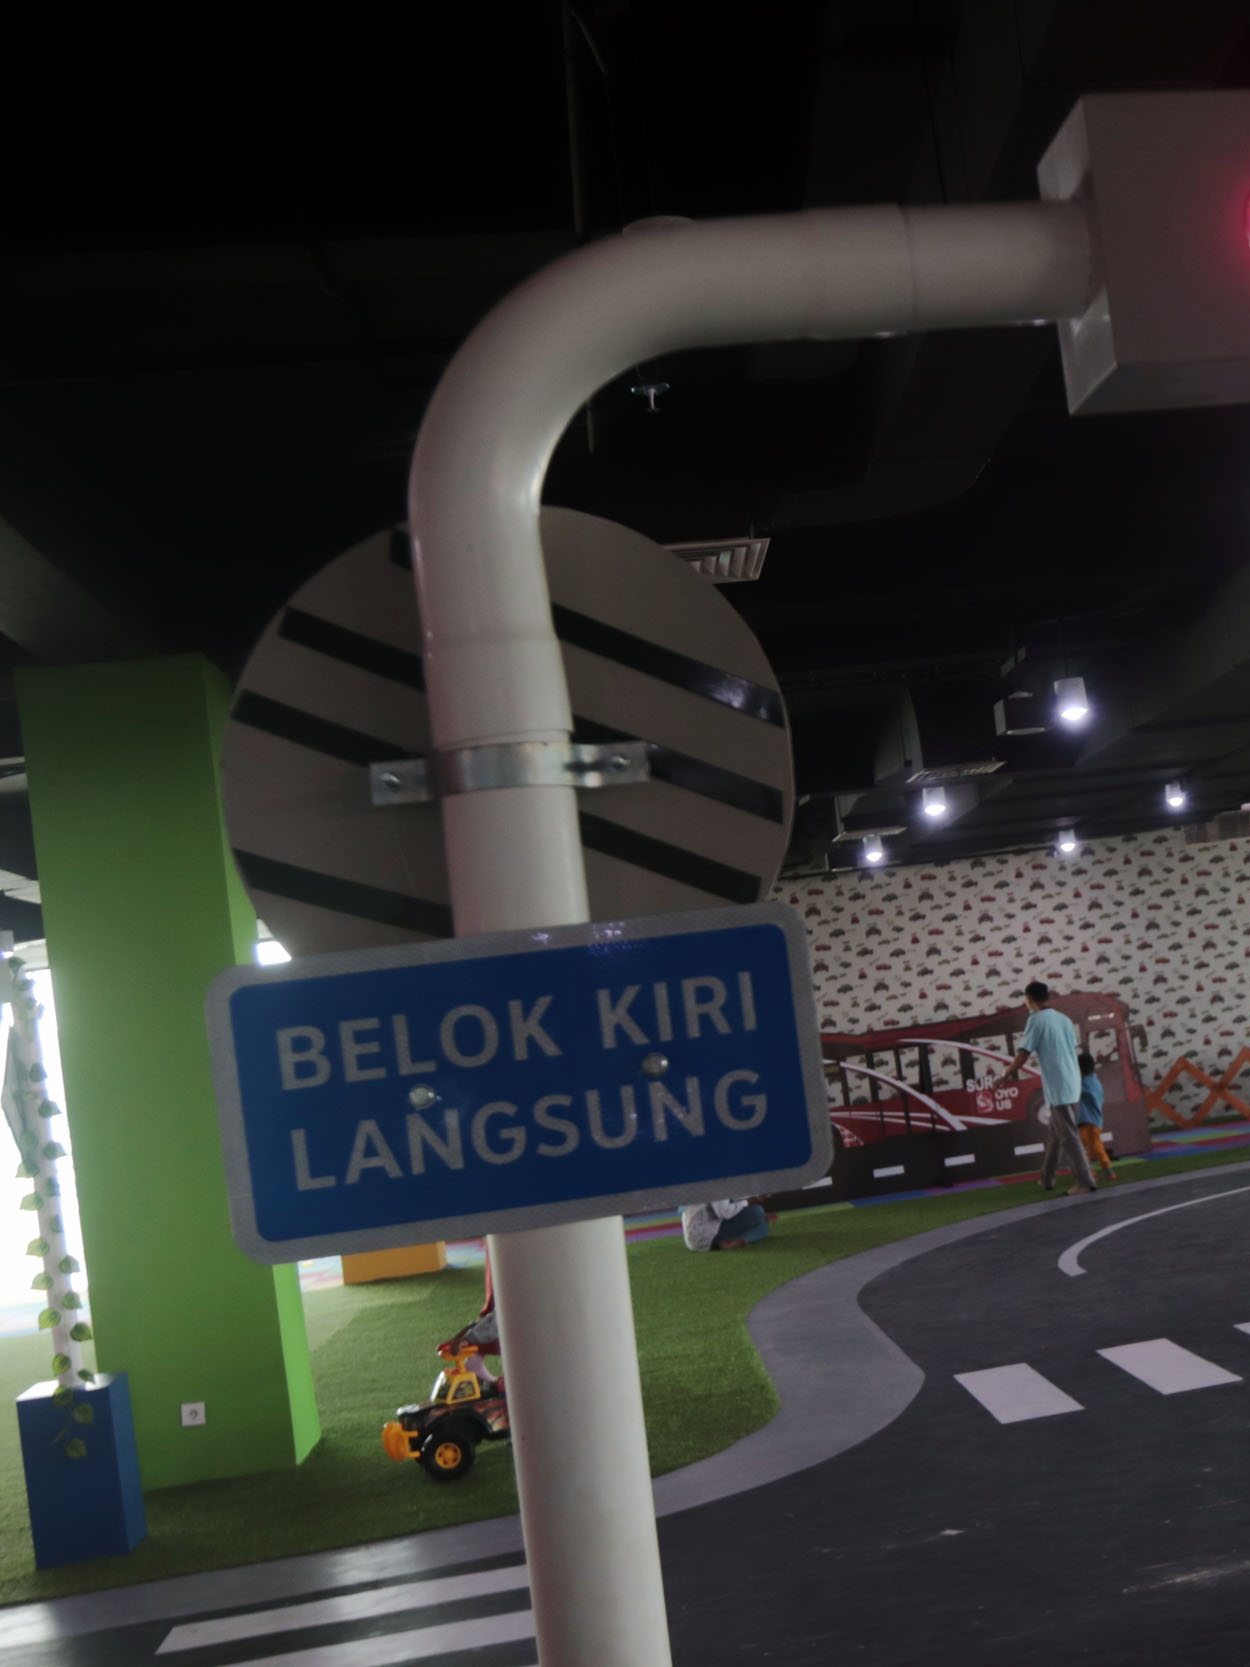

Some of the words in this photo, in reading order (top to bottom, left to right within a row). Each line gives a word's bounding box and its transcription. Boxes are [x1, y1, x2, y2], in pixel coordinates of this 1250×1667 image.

[276, 996, 562, 1091] BELOK
[597, 972, 757, 1049] KIRI
[290, 1069, 768, 1191] LANGSUNG
